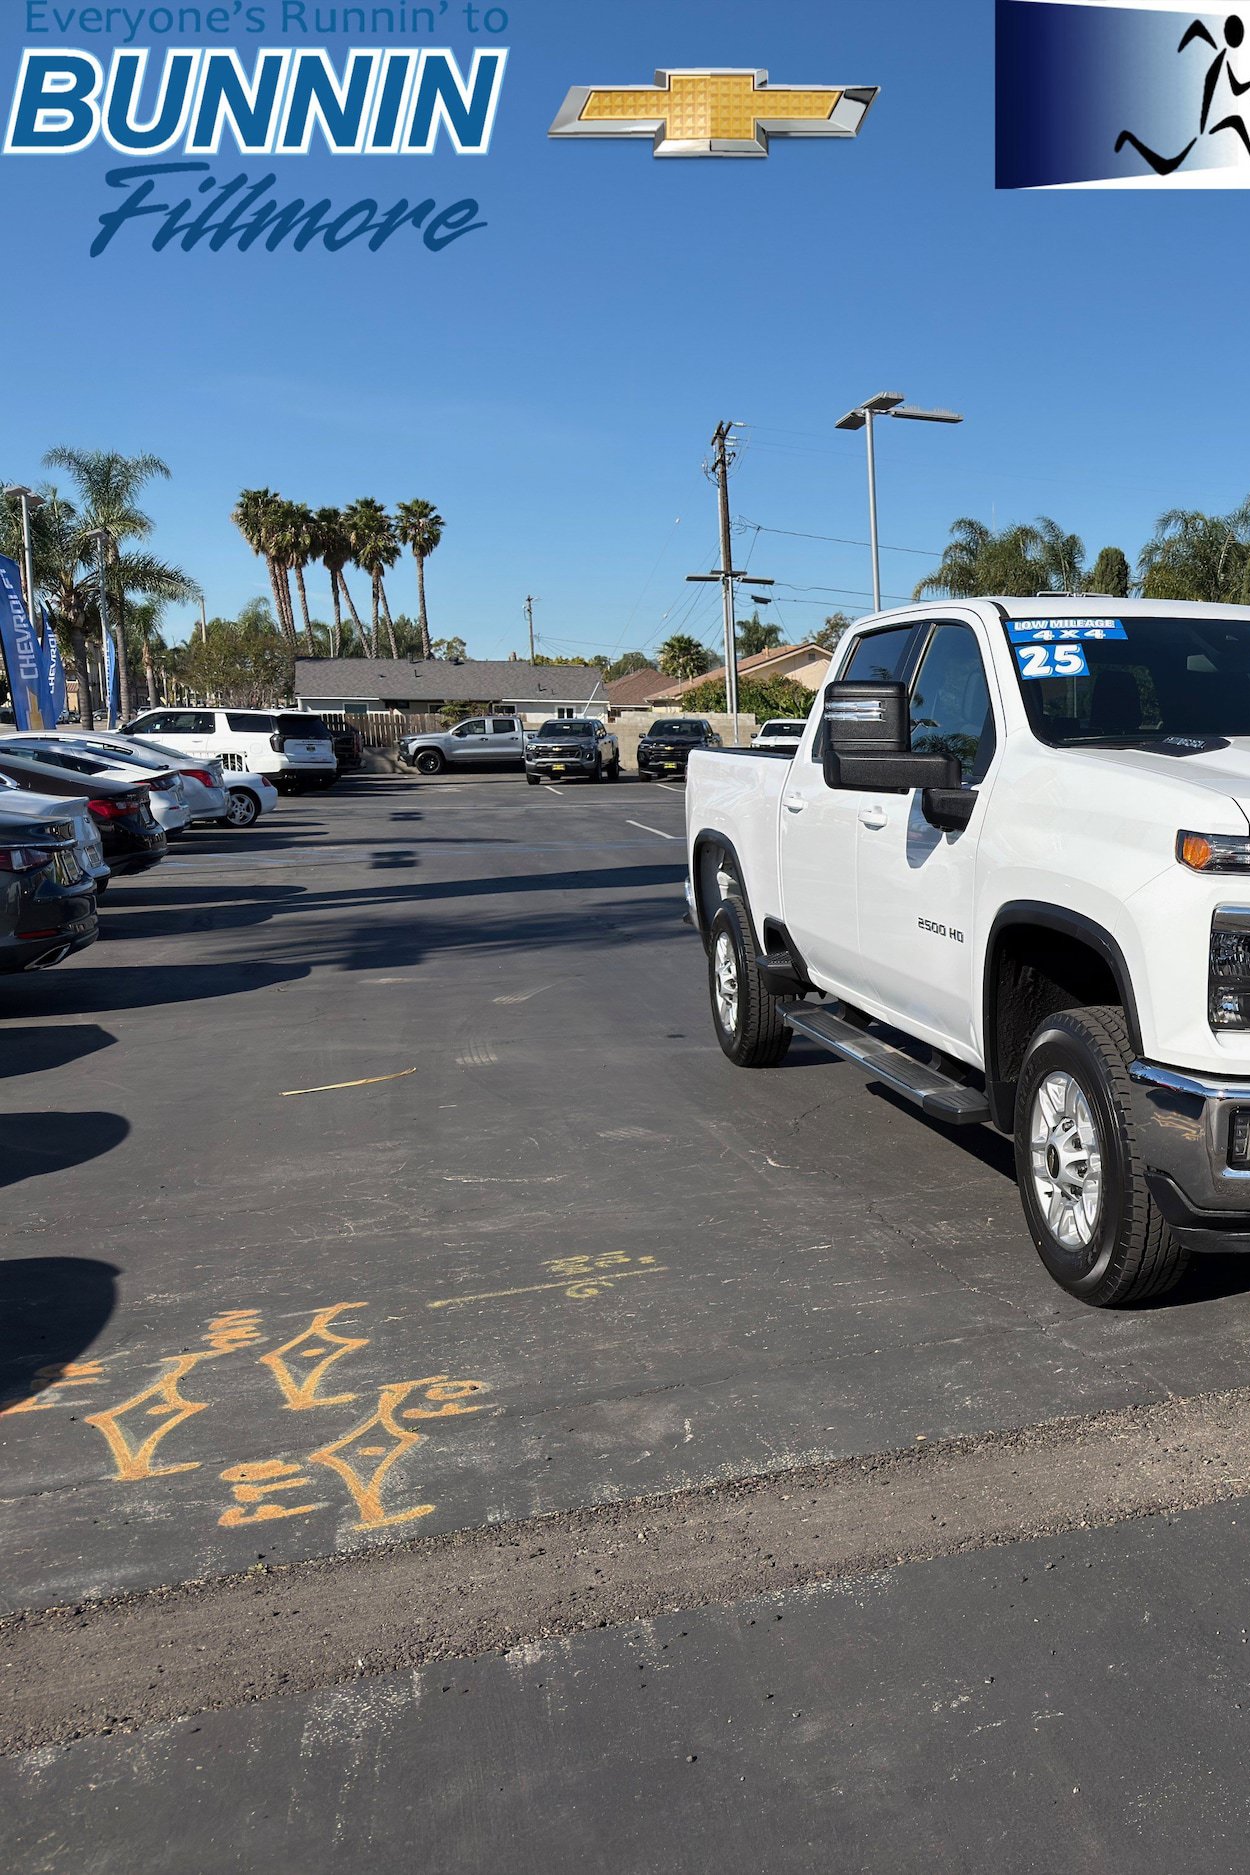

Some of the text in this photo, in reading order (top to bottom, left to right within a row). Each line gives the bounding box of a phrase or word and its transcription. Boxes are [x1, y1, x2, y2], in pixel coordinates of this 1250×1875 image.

[1014, 619, 1115, 630] LOW MILEAGE
[1018, 645, 1085, 677] 25
[918, 917, 964, 944] 2500 HD
